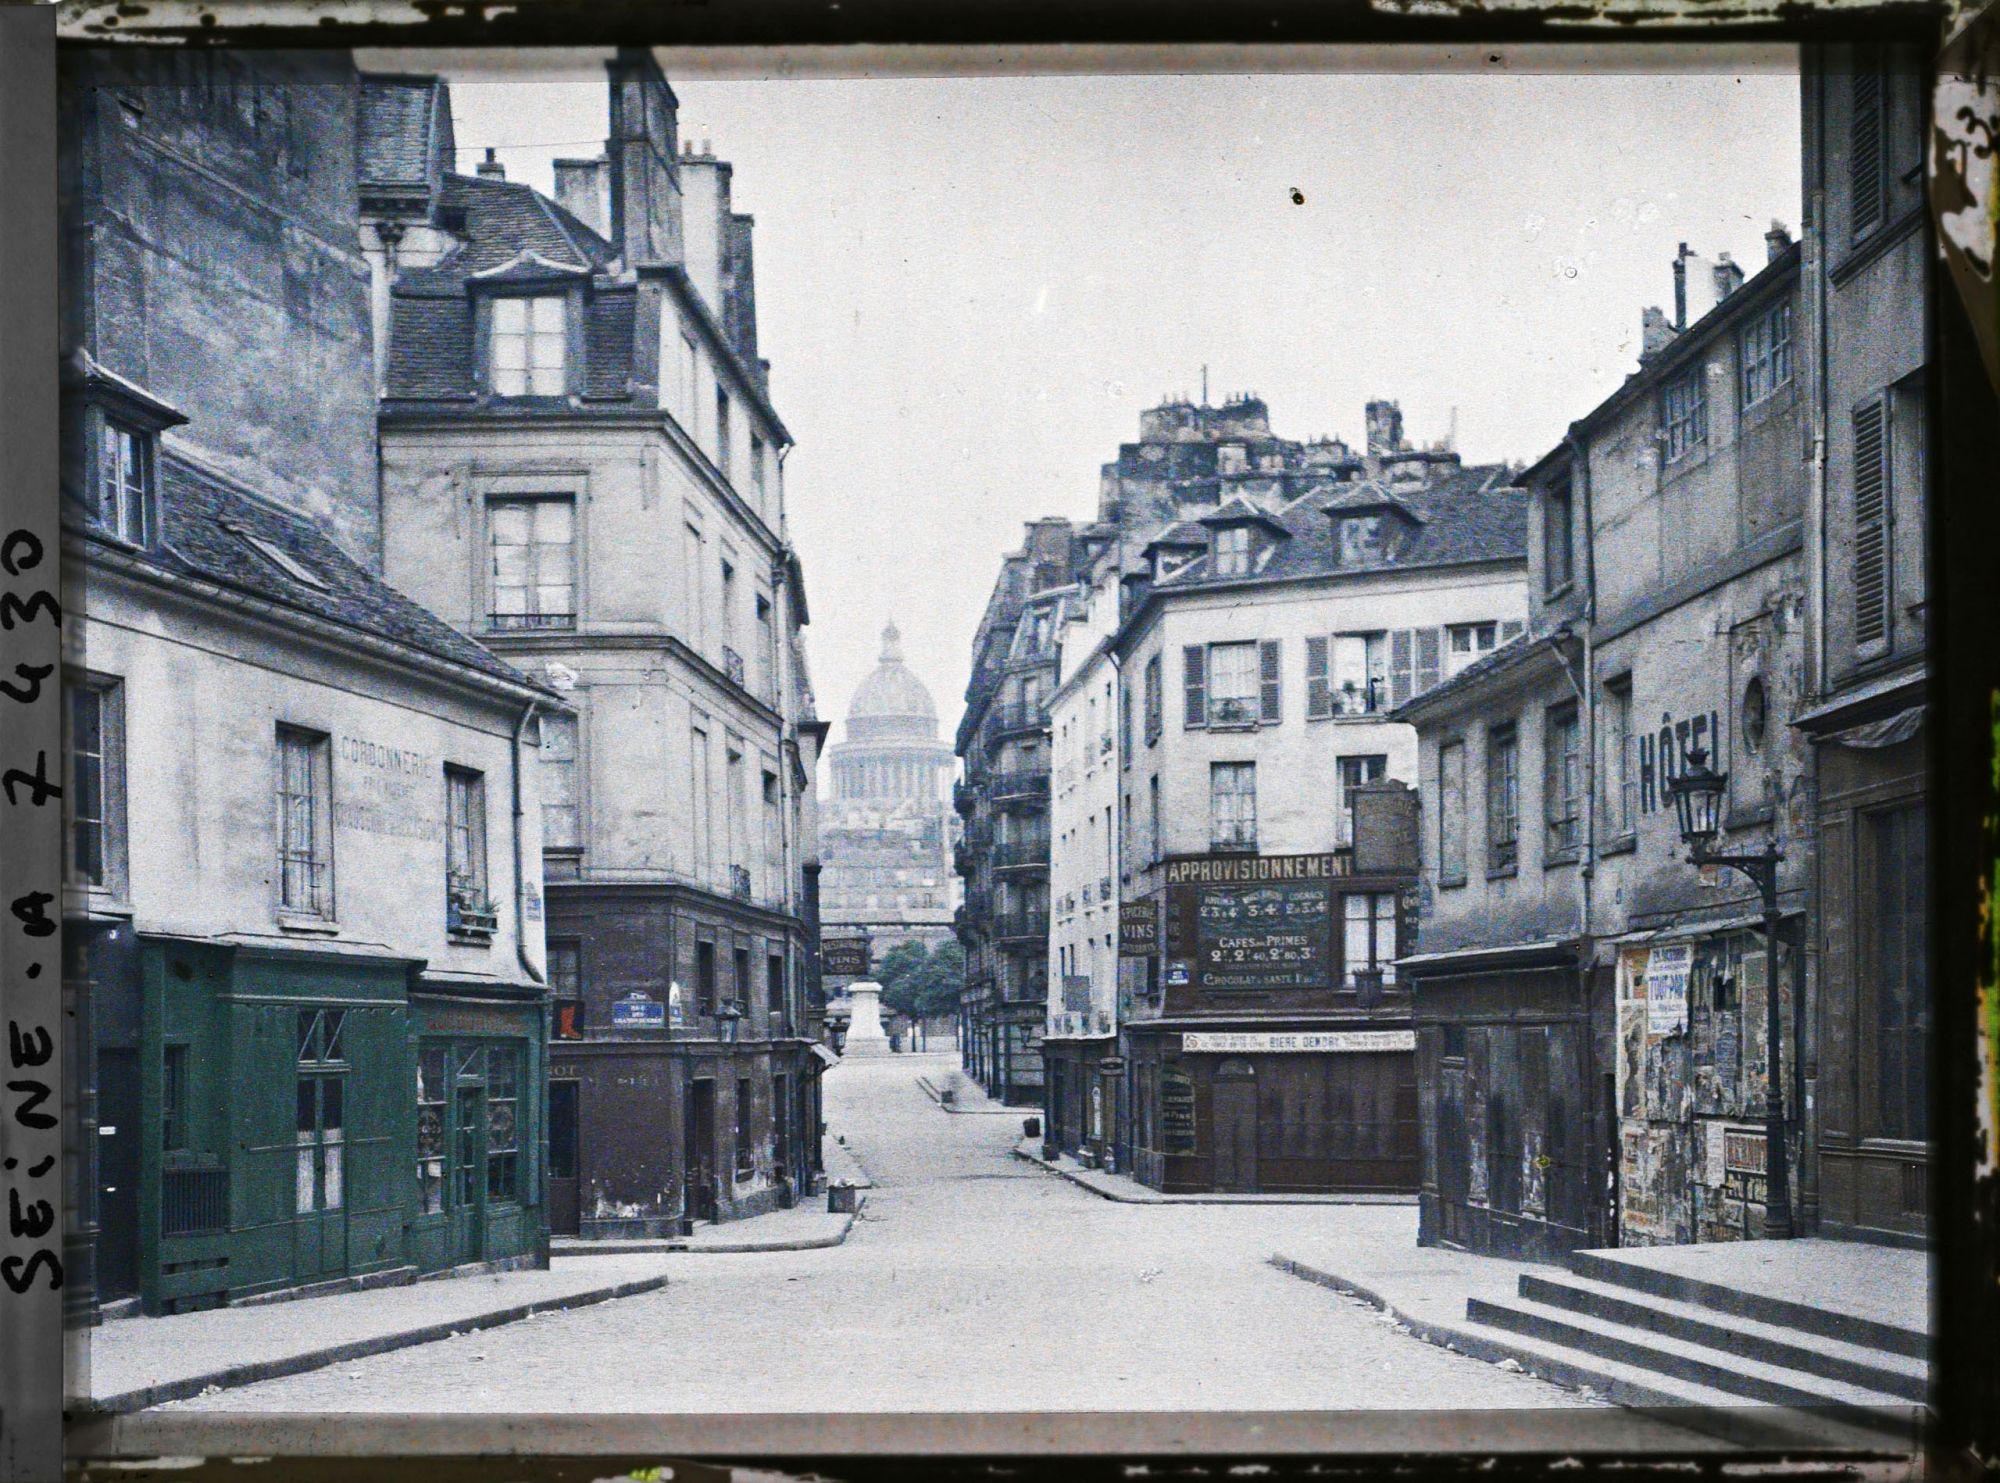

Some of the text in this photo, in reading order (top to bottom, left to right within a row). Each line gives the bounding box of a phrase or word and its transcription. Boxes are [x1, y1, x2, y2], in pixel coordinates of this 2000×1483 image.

[342, 735, 432, 779] CORDONNERIE
[1168, 855, 1352, 883] APPROVISIONNEMENT
[1122, 924, 1154, 939] VINS
[1266, 935, 1308, 947] PRIMES
[1203, 972, 1257, 985] CHOCOLAT
